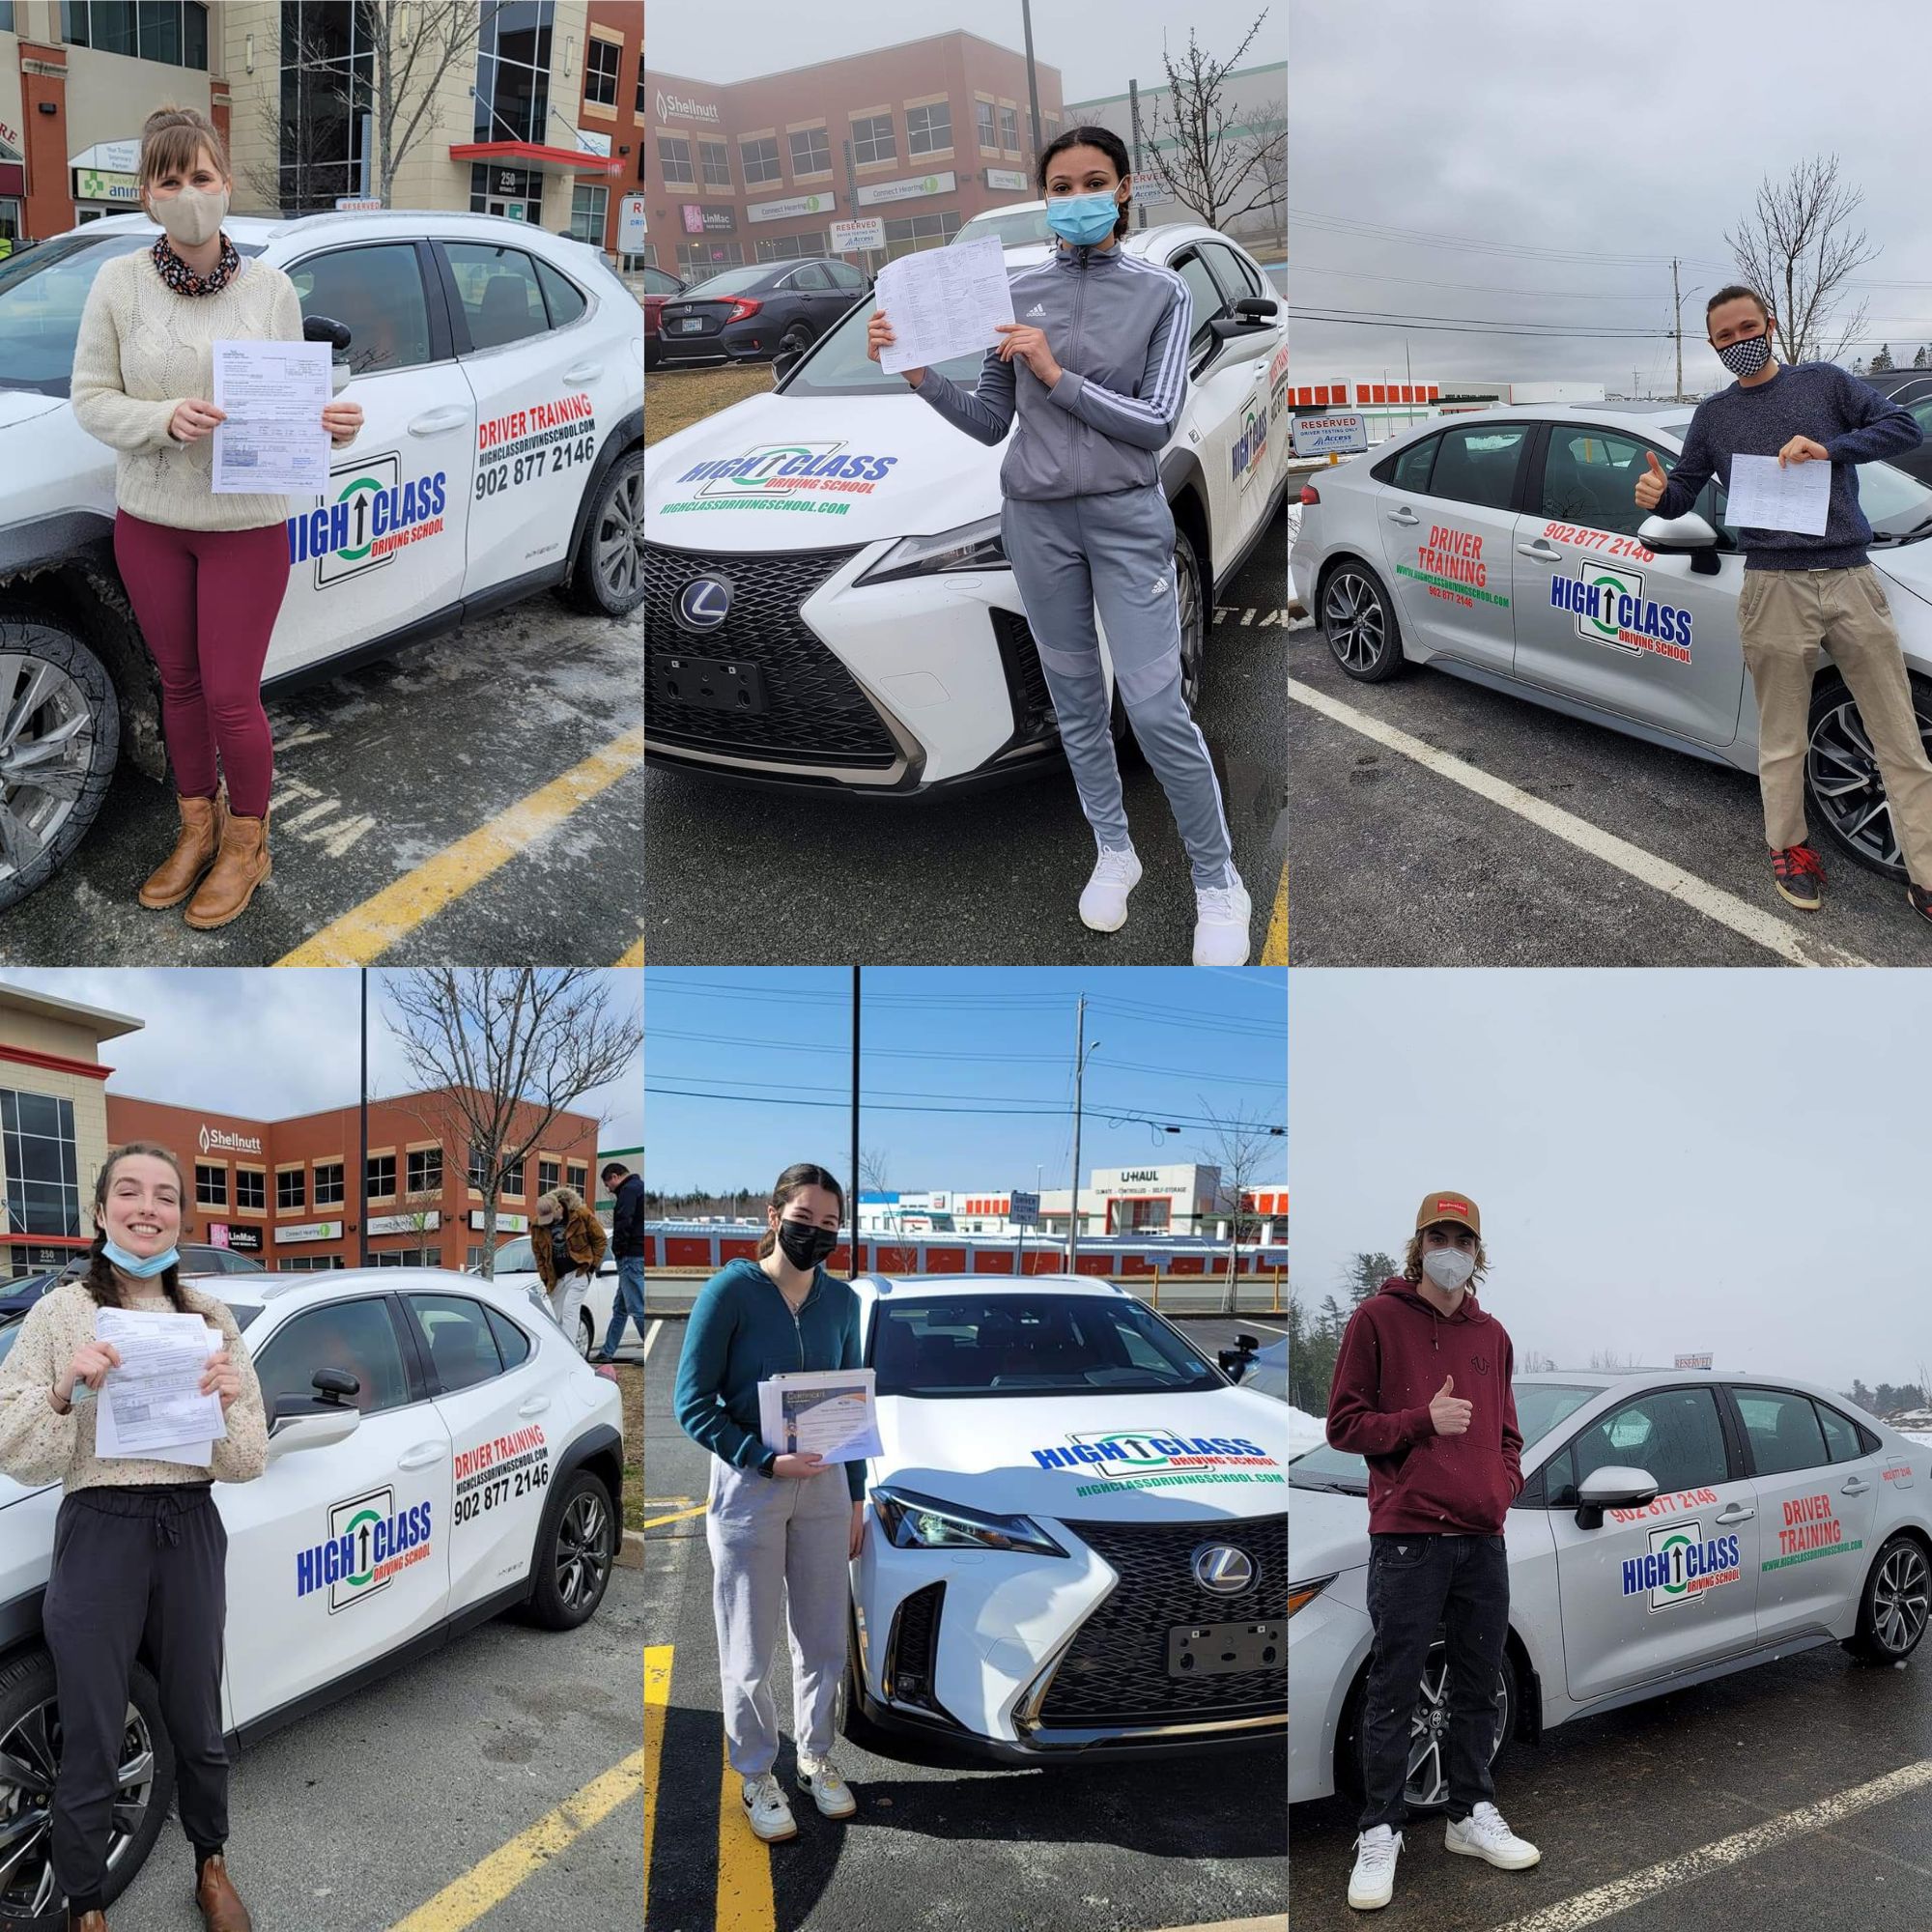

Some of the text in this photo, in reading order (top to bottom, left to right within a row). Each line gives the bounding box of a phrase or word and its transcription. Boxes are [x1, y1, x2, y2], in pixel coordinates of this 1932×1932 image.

[667, 95, 719, 118] Shellnutt
[500, 171, 516, 186] 250
[1133, 172, 1166, 184] ERVED
[701, 213, 730, 223] LinMac
[836, 220, 877, 232] RESERVED
[479, 393, 592, 450] DRIVER TRAINING
[1301, 417, 1356, 430] RESERVED
[479, 418, 596, 468] HIGHCLASSDRIVINGSCHOOL.COM
[475, 436, 595, 500] 902 877 2146
[676, 454, 898, 484] HIGH CLASS
[764, 477, 877, 494] DRIVING SCHOOL
[371, 471, 446, 537] CLASS
[660, 498, 851, 516] HIGHCLASSDRIVINGSCHOOL.COM
[371, 518, 444, 557] DRIVING SCHOOL
[1429, 525, 1483, 560] DRIVER
[1543, 522, 1655, 563] 902 877 2146
[1418, 547, 1487, 588] TRAINING
[1396, 564, 1510, 608] WWW.HIGHCLASSDRIVINGSCHOOL.COM
[1429, 585, 1473, 608] 902 877 2146
[1550, 575, 1692, 646] HIGH CLASS
[1617, 629, 1691, 665] DRIVING SCHOOL
[210, 1129, 261, 1150] Shellnutt
[1121, 1170, 1159, 1182] U-HAUL
[228, 1232, 257, 1242] LinMac
[40, 1250, 54, 1259] 250
[454, 1424, 546, 1481] DRIVER TRAINING
[1031, 1437, 1266, 1470] HIGH CLASS
[1167, 1456, 1280, 1466] DRIVING SCHOOL
[456, 1447, 549, 1496] HIGHCLASSDRIVINGSCHOOL.COM
[1076, 1473, 1286, 1497] HIGHCLASSDRIVINGSCHOOL.COM
[454, 1463, 549, 1526] 902 877 2146
[1648, 1495, 1676, 1515] 877
[1677, 1489, 1718, 1509] 2146
[1782, 1494, 1833, 1526] DRIVER
[297, 1500, 432, 1598] HIGH CLASS
[1778, 1520, 1841, 1555] TRAINING
[373, 1543, 431, 1582] DRIVING SCHOOL
[1622, 1534, 1740, 1596] HIGH CLASS
[1761, 1539, 1863, 1573] WWW.HIGHCLASSDRIVINGSCHOOL.COM
[1687, 1569, 1740, 1593] DRIVING SCHOOL
